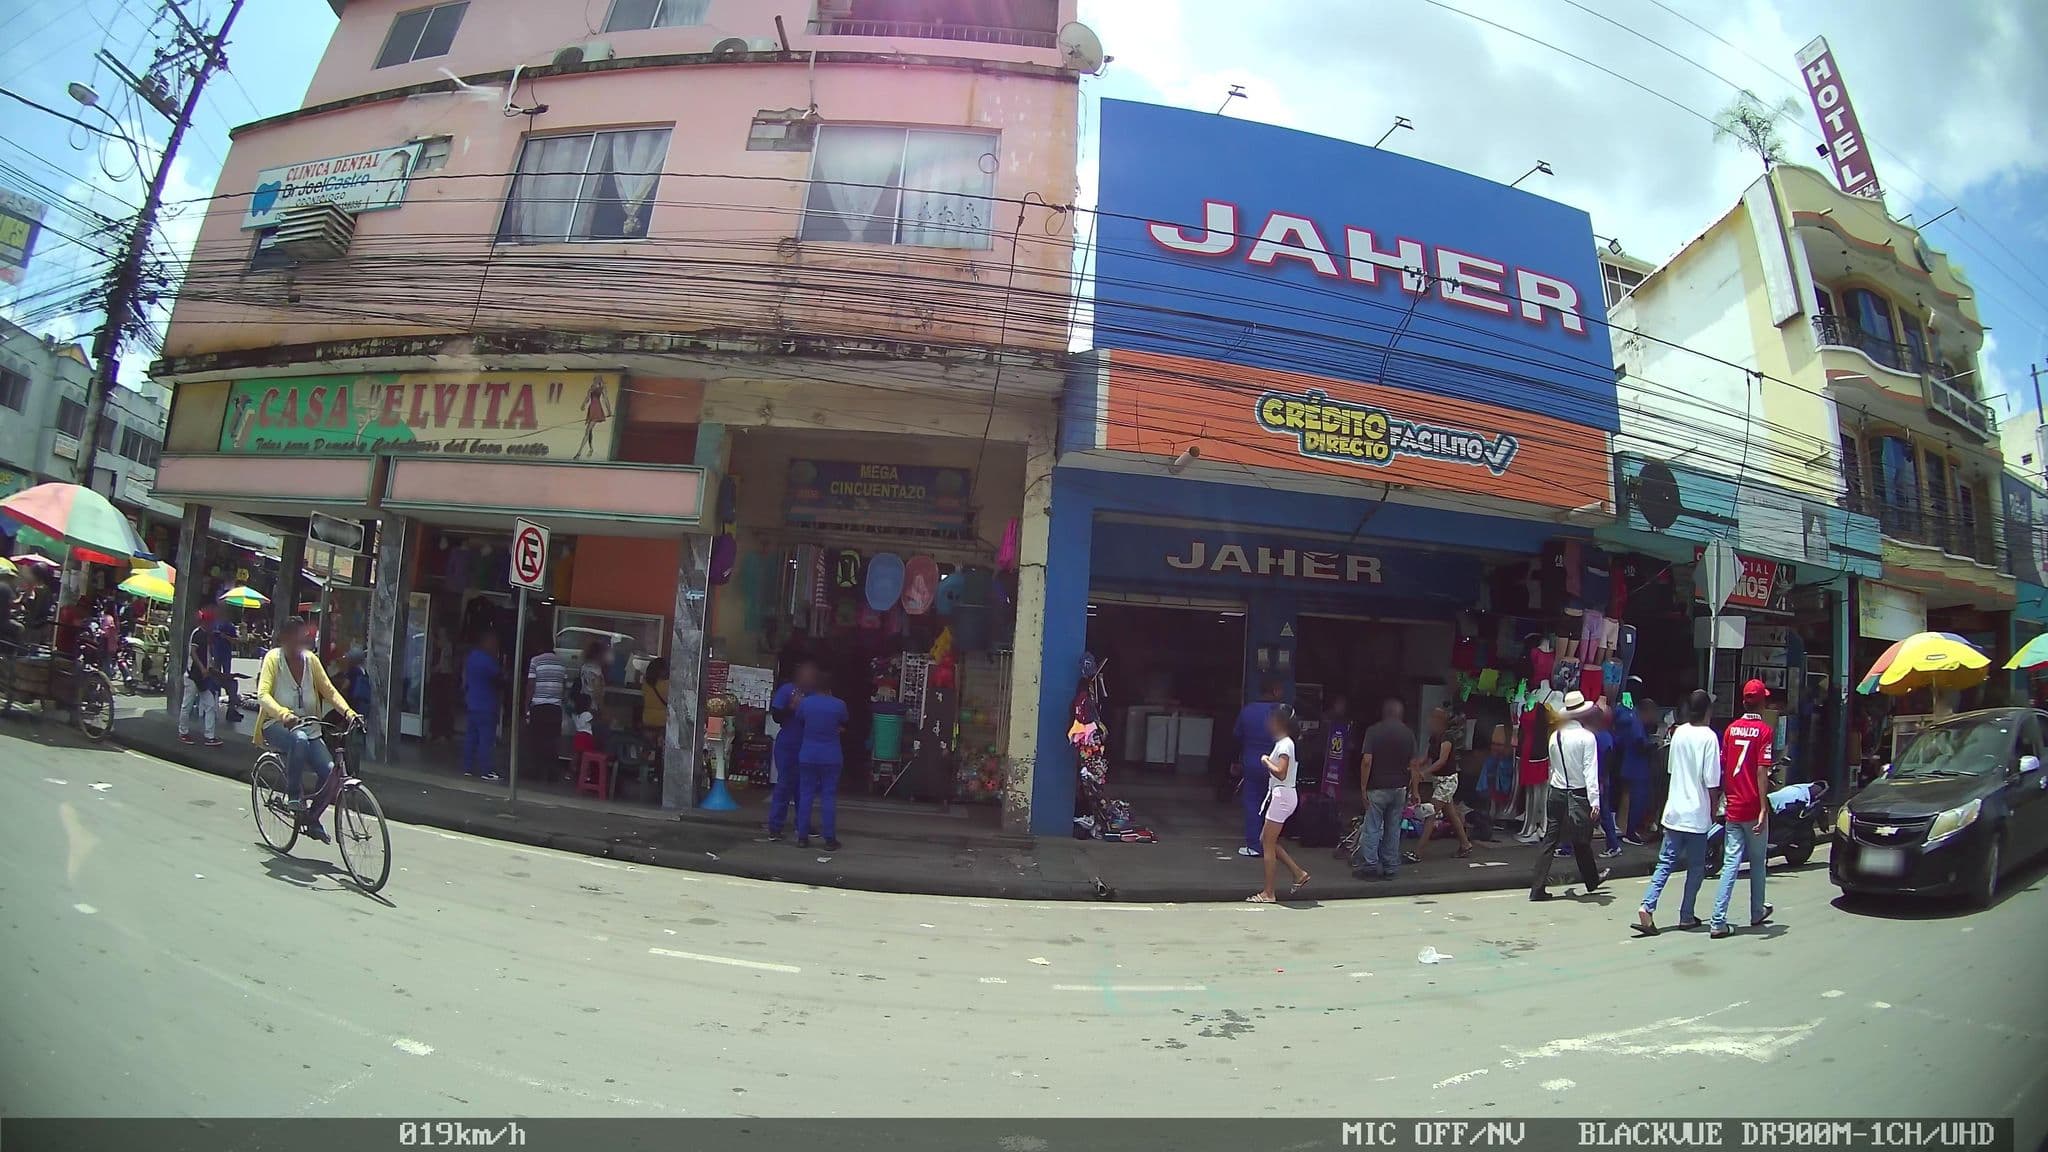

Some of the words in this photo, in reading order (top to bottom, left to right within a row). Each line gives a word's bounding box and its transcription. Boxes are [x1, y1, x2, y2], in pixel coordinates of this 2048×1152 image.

[1807, 58, 1867, 188] HOTEL
[286, 161, 330, 182] CLINICA
[332, 153, 380, 174] DENTAL
[1148, 199, 1586, 336] JAHER
[258, 383, 349, 429] CASA
[1262, 396, 1388, 440] CRÉDITO
[1304, 431, 1389, 460] DIRECTO
[1389, 424, 1483, 459] FACILITO
[860, 463, 899, 480] MEGA
[830, 480, 926, 500] CINCUENTAZO
[1166, 541, 1383, 583] JAHER
[1729, 726, 1760, 738] RONALDO
[1732, 739, 1751, 777] 7
